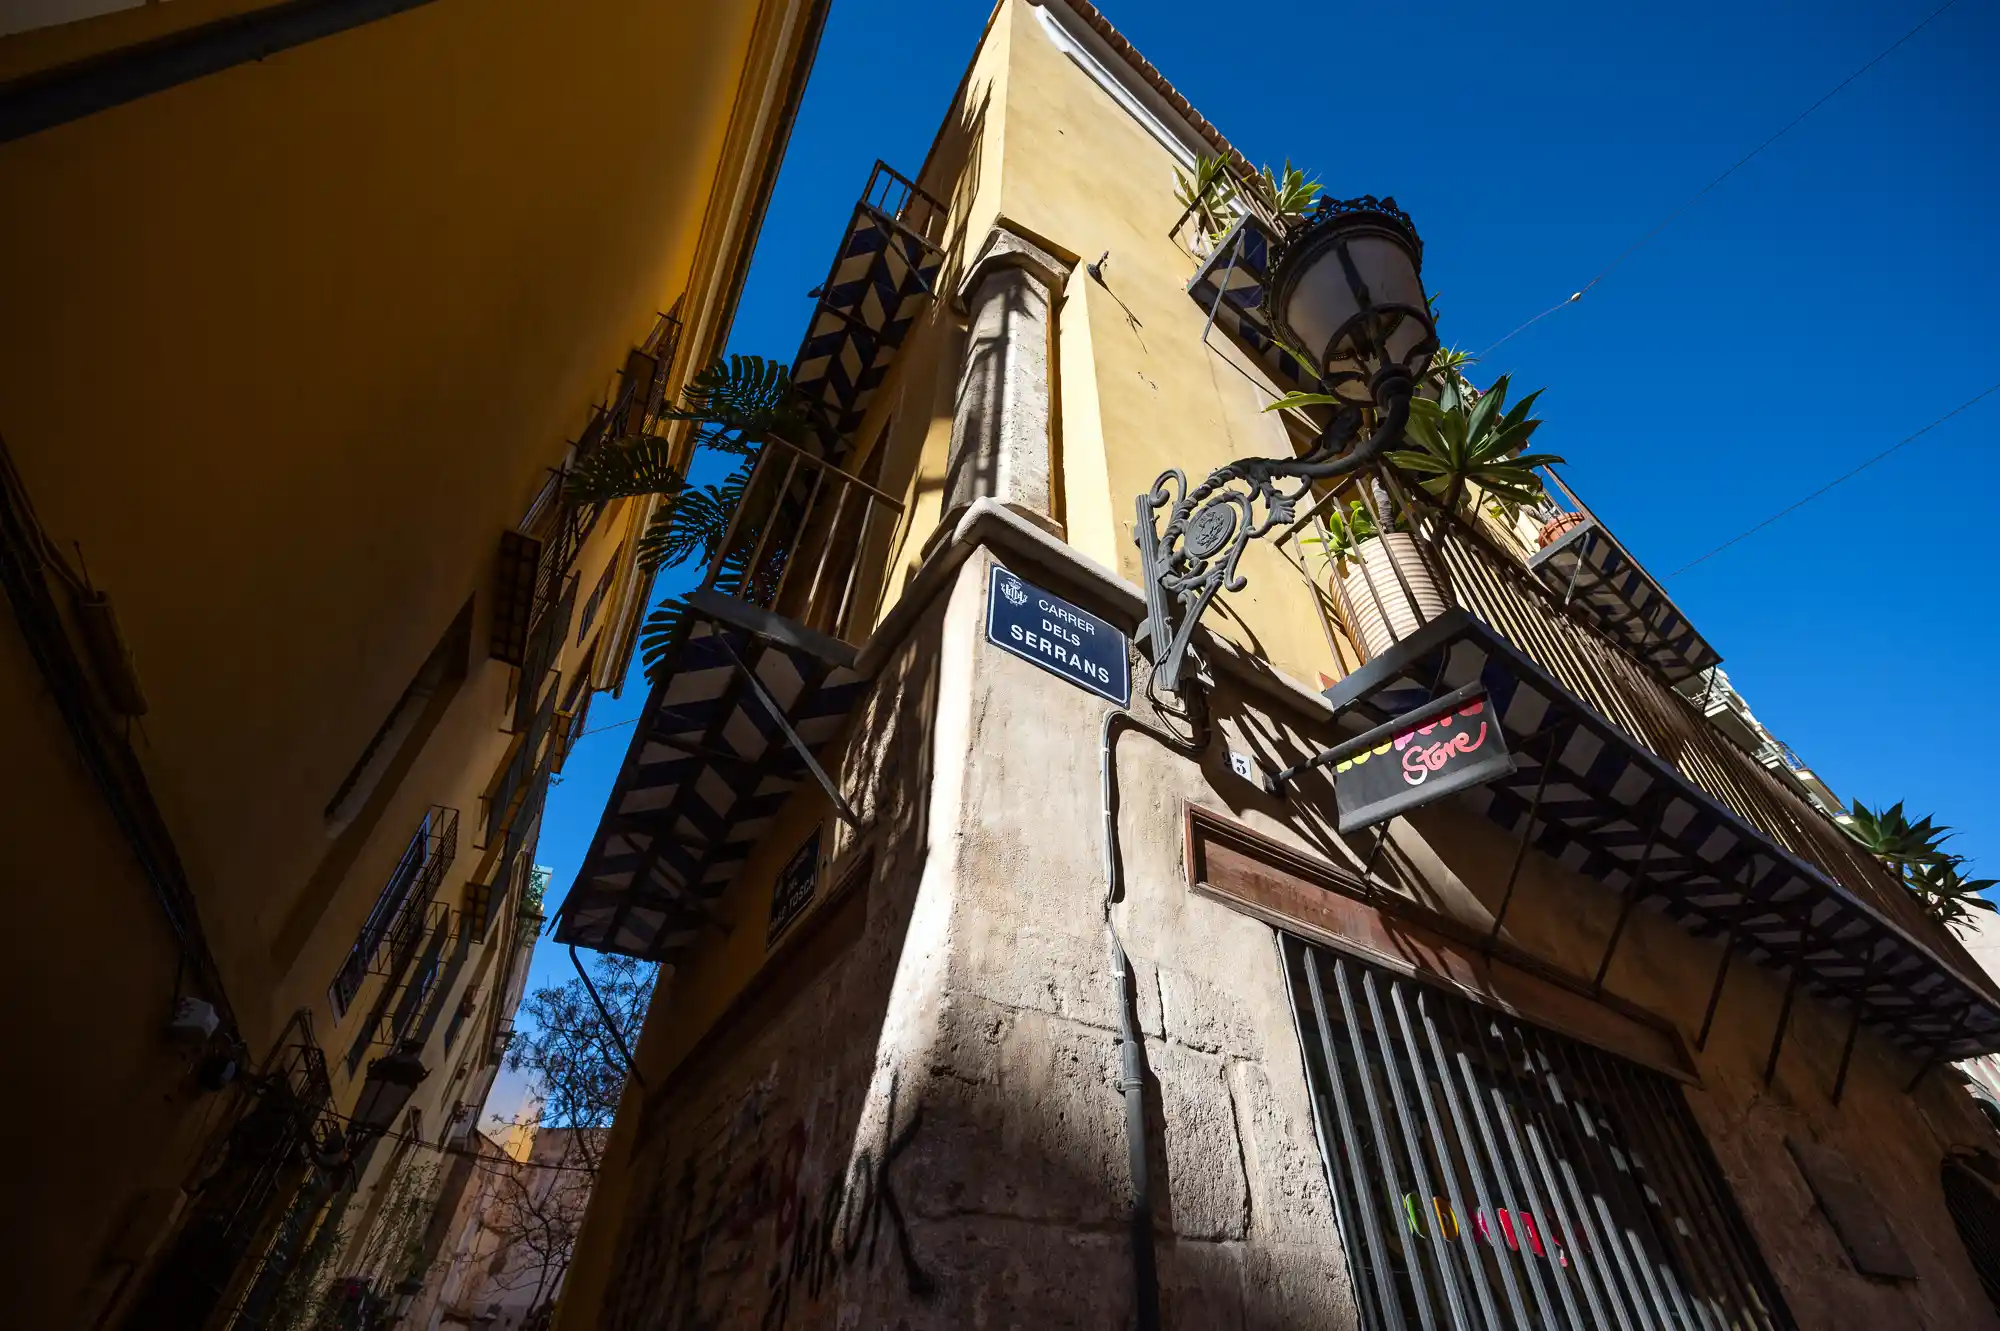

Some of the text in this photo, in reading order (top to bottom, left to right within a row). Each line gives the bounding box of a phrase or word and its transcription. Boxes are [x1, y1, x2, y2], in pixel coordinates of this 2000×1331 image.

[1038, 599, 1095, 636] CARRER
[1042, 618, 1081, 647] DELS
[1010, 624, 1110, 684] SERRANS
[1402, 721, 1487, 785] Store
